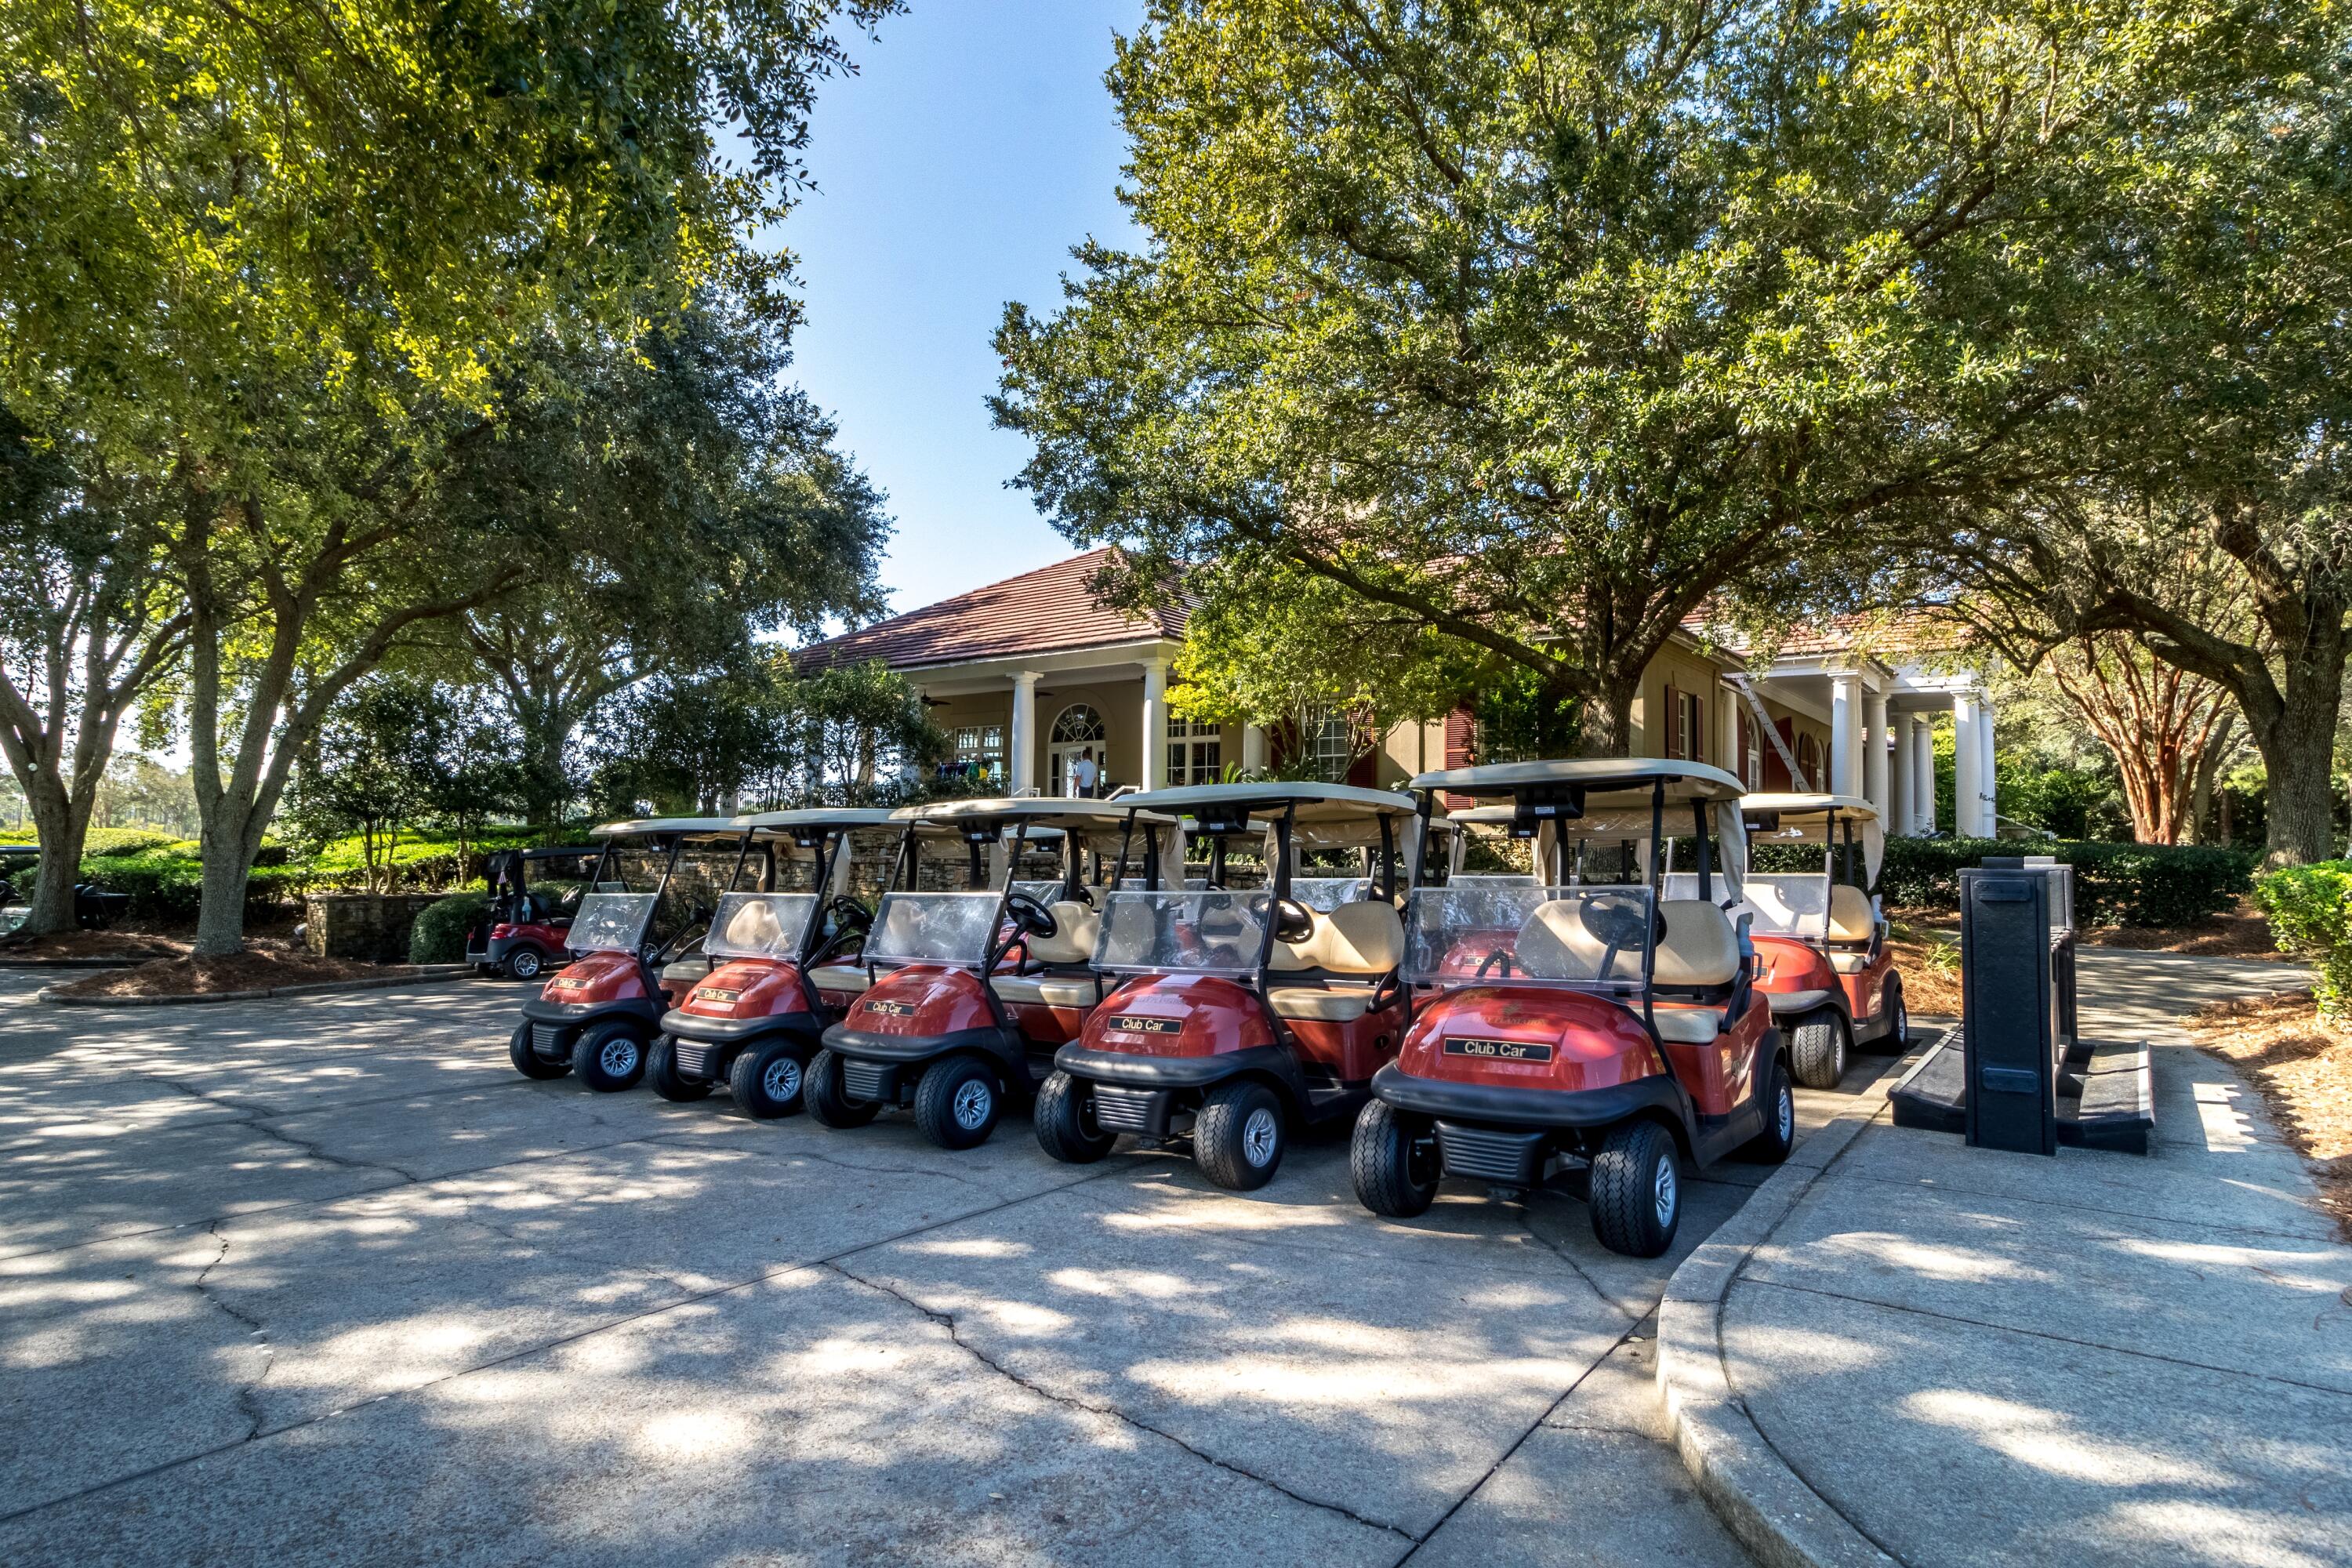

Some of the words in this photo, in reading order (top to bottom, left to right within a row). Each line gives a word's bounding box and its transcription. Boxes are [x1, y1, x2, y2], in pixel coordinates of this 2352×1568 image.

[873, 1002, 887, 1012] Club
[888, 1004, 902, 1014] Car
[1122, 1018, 1142, 1029] Club
[1145, 1020, 1163, 1031] Car
[1465, 1040, 1495, 1055] Club
[1499, 1043, 1526, 1058] Car
